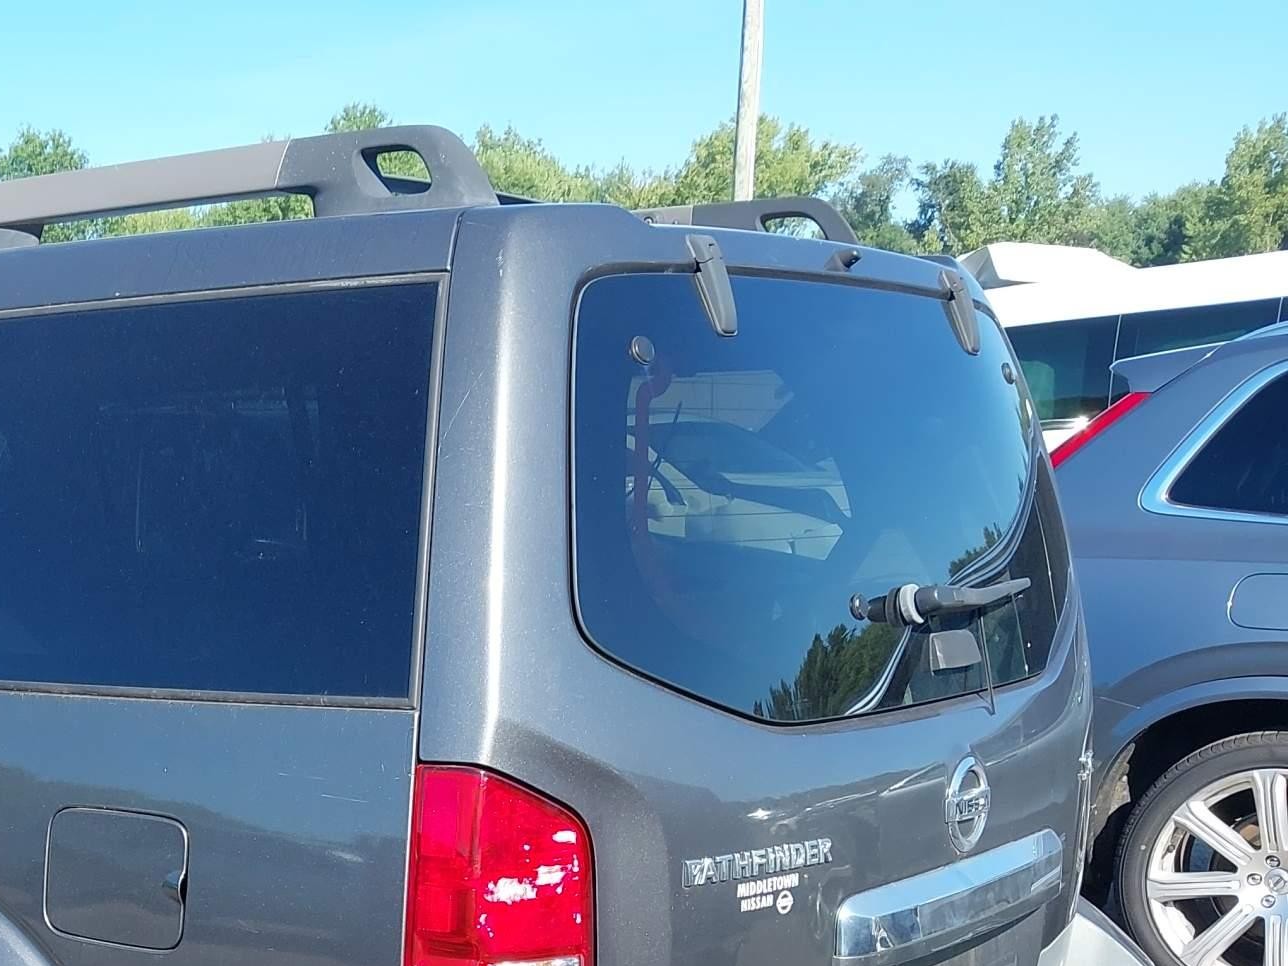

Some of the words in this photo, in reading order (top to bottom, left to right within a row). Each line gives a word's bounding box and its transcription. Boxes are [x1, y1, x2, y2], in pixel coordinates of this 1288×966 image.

[681, 838, 833, 889] PATHFINDER
[737, 873, 800, 898] MIDDLETOWN
[740, 895, 774, 913] NISSAN
